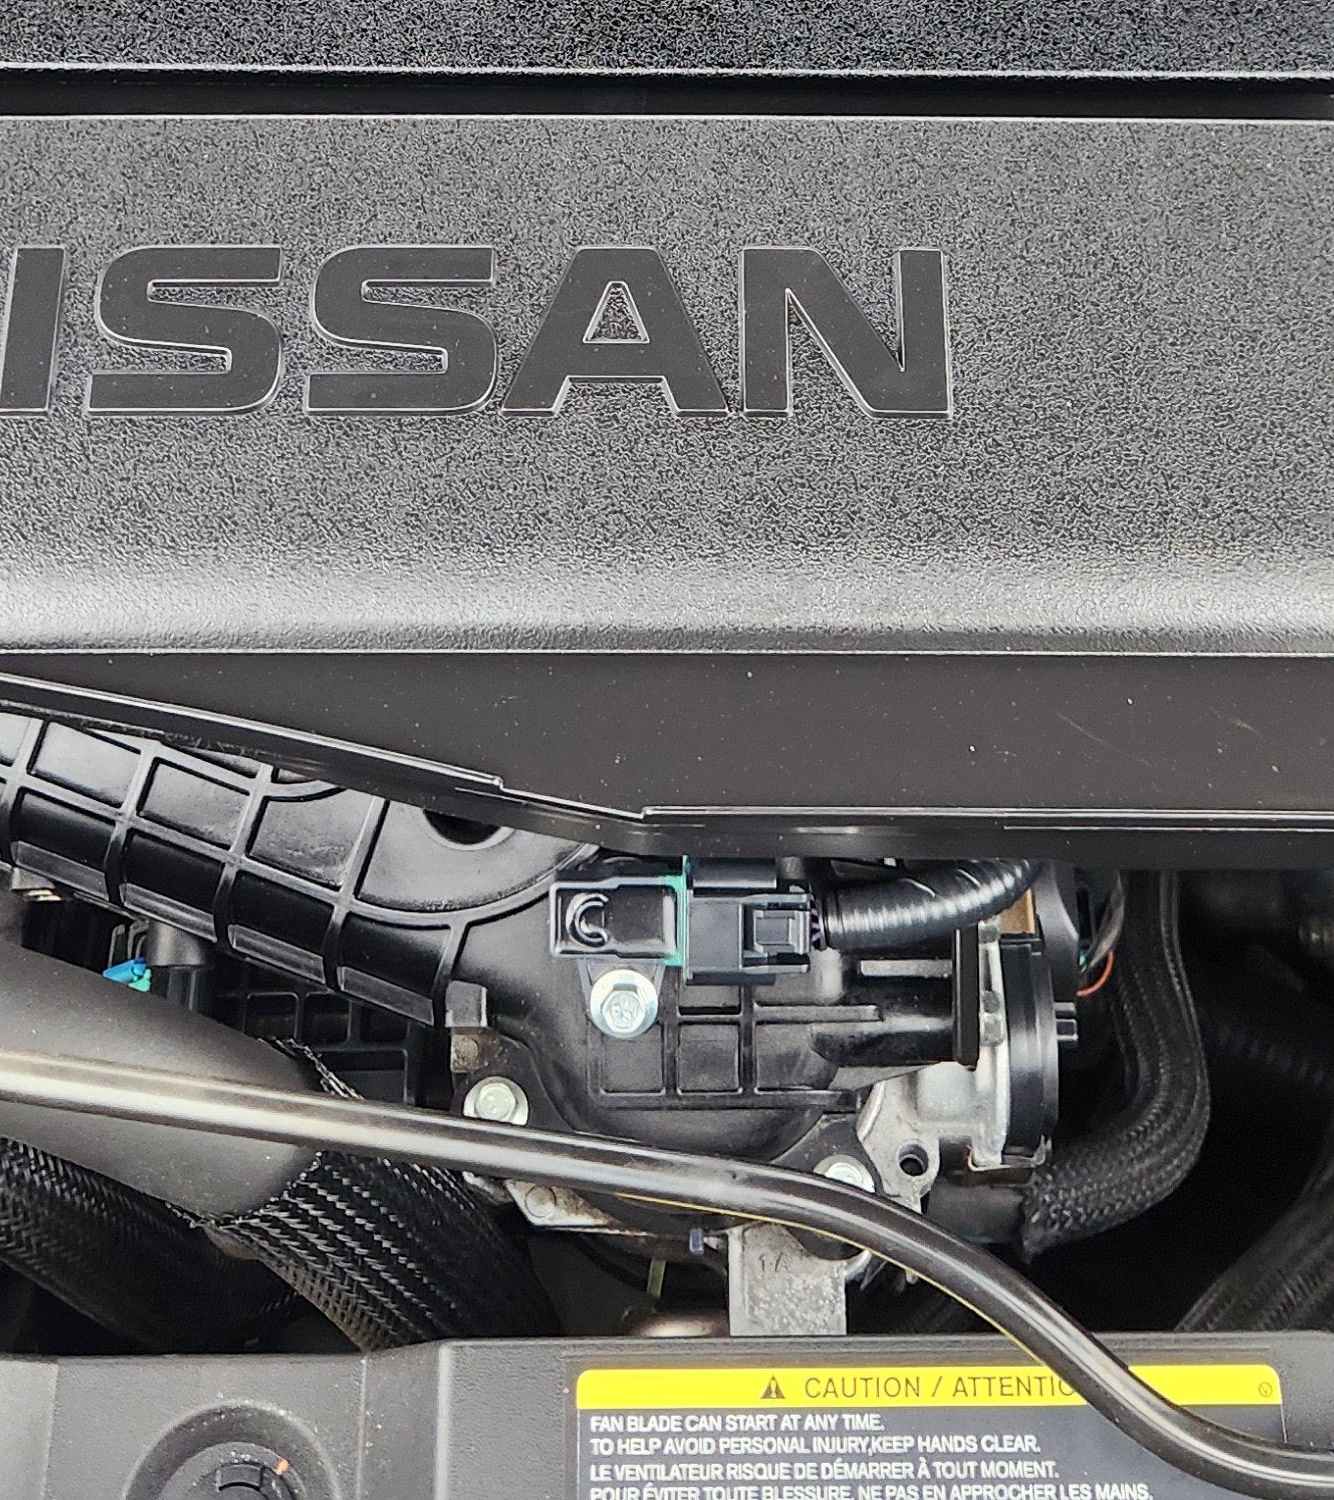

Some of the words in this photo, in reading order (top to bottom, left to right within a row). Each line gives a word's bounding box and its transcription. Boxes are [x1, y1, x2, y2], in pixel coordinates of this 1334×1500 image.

[804, 1376, 921, 1399] CAUTION
[952, 1375, 1078, 1398] ATTENTIO
[590, 1415, 624, 1432] FAN
[626, 1415, 683, 1432] BLADE
[685, 1414, 722, 1432] CAN
[725, 1414, 778, 1432] START
[780, 1414, 802, 1431] AT
[803, 1414, 839, 1431] ANY
[841, 1413, 885, 1431] TIME.
[589, 1438, 614, 1455] TO
[617, 1438, 662, 1455] HELP
[663, 1437, 716, 1455] AVOID
[719, 1436, 811, 1454] PERSONAL
[917, 1435, 978, 1453] HANDS
[980, 1434, 1042, 1453] CLEAR.
[590, 1464, 612, 1481] LE
[613, 1463, 724, 1481] VENTILATEUR
[726, 1463, 792, 1480] RISQUE
[794, 1463, 819, 1480] DE
[820, 1457, 915, 1480] DÉMARRER
[917, 1456, 931, 1479] À
[932, 1461, 978, 1479] TOUT
[980, 1460, 1060, 1479] MOMENT.
[590, 1487, 641, 1500] POUR
[703, 1486, 759, 1500] TOUTE
[858, 1485, 883, 1500] NE
[885, 1484, 919, 1500] PAS
[922, 1484, 946, 1500] EN
[950, 1484, 1057, 1500] APPROCHER
[1059, 1483, 1092, 1500] LES
